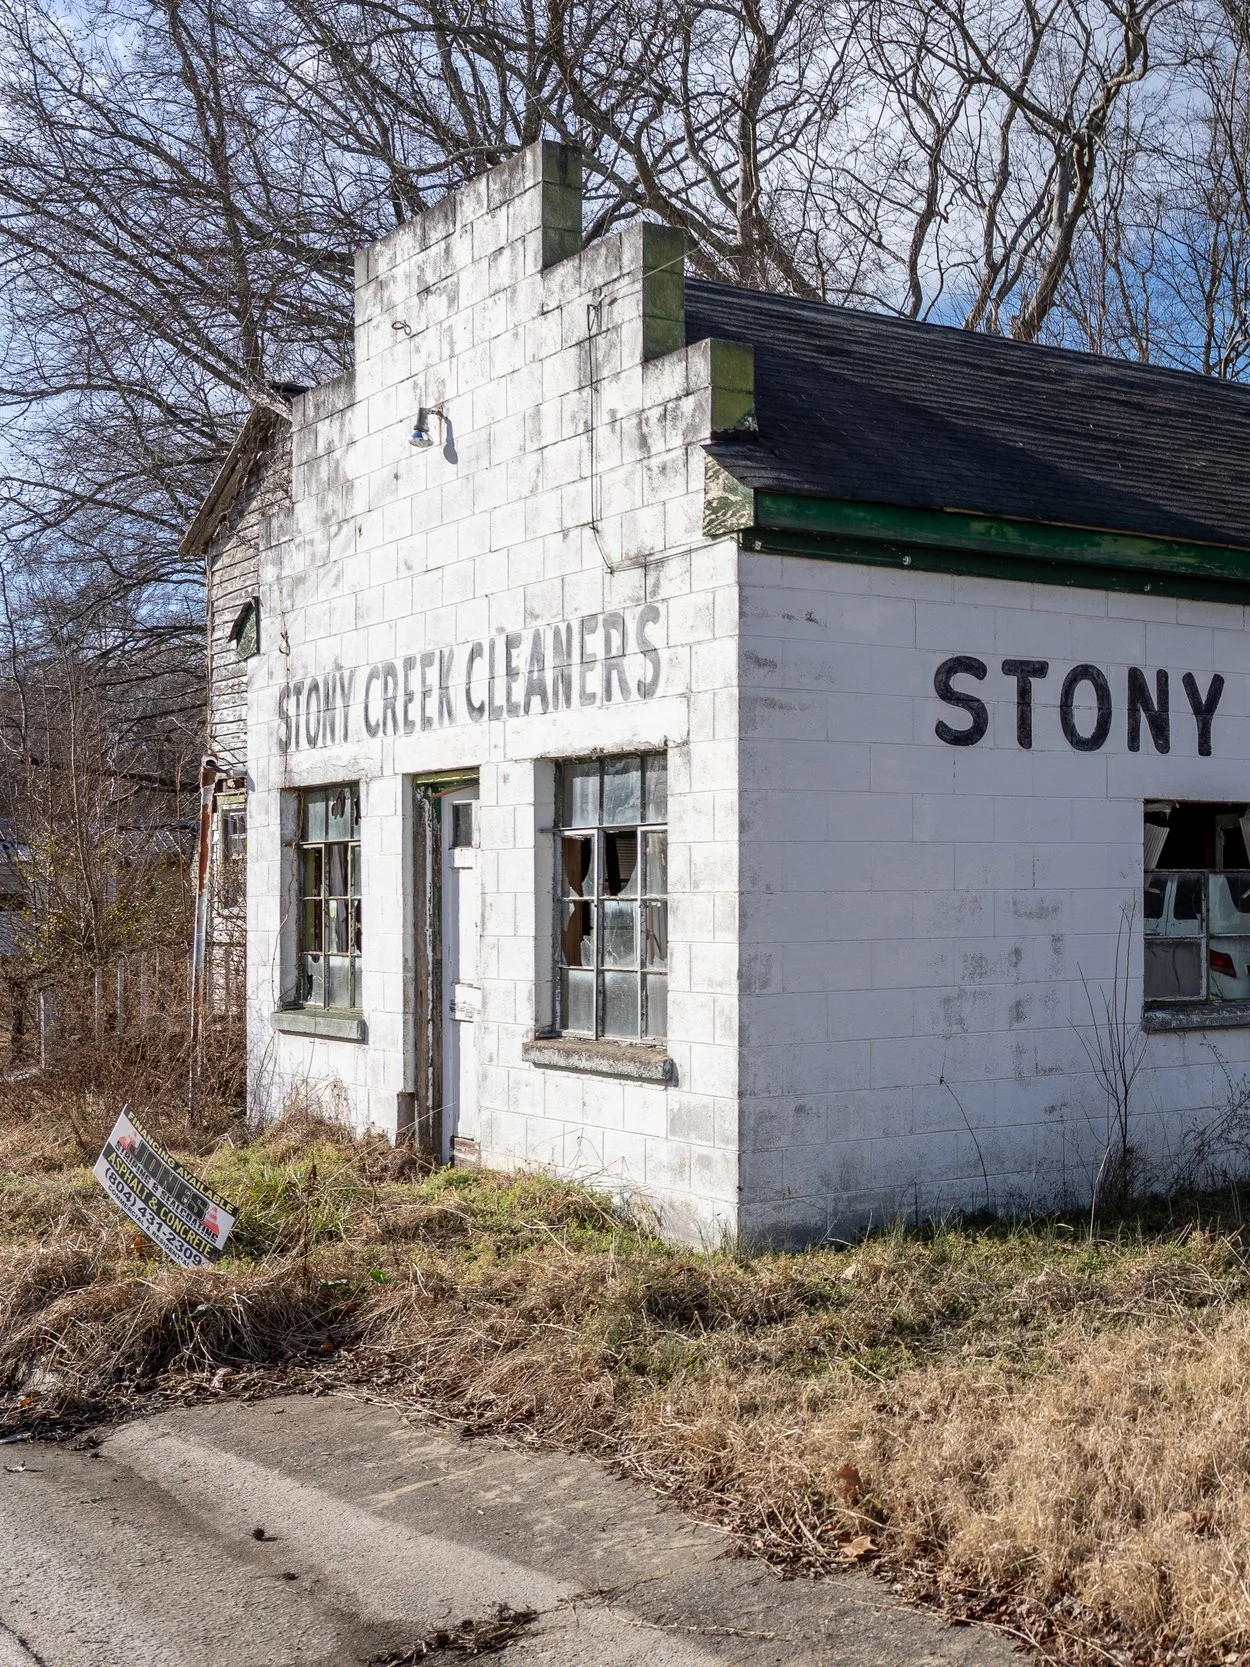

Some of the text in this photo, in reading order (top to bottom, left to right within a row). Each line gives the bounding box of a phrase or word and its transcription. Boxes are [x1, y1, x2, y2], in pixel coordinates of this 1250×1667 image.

[278, 604, 661, 753] STONY CREEK CLEANERS
[933, 655, 1225, 757] STONY
[108, 1152, 214, 1257] ASPHALT & CONCRETE
[108, 1185, 145, 1227] COMMERCIAL
[115, 1143, 219, 1243] STRIPING & SEALCOATING
[128, 1111, 233, 1214] FINANCING AVAILABLE
[128, 1139, 210, 1221] JONES
[104, 1167, 203, 1266] (804) 431-2309
